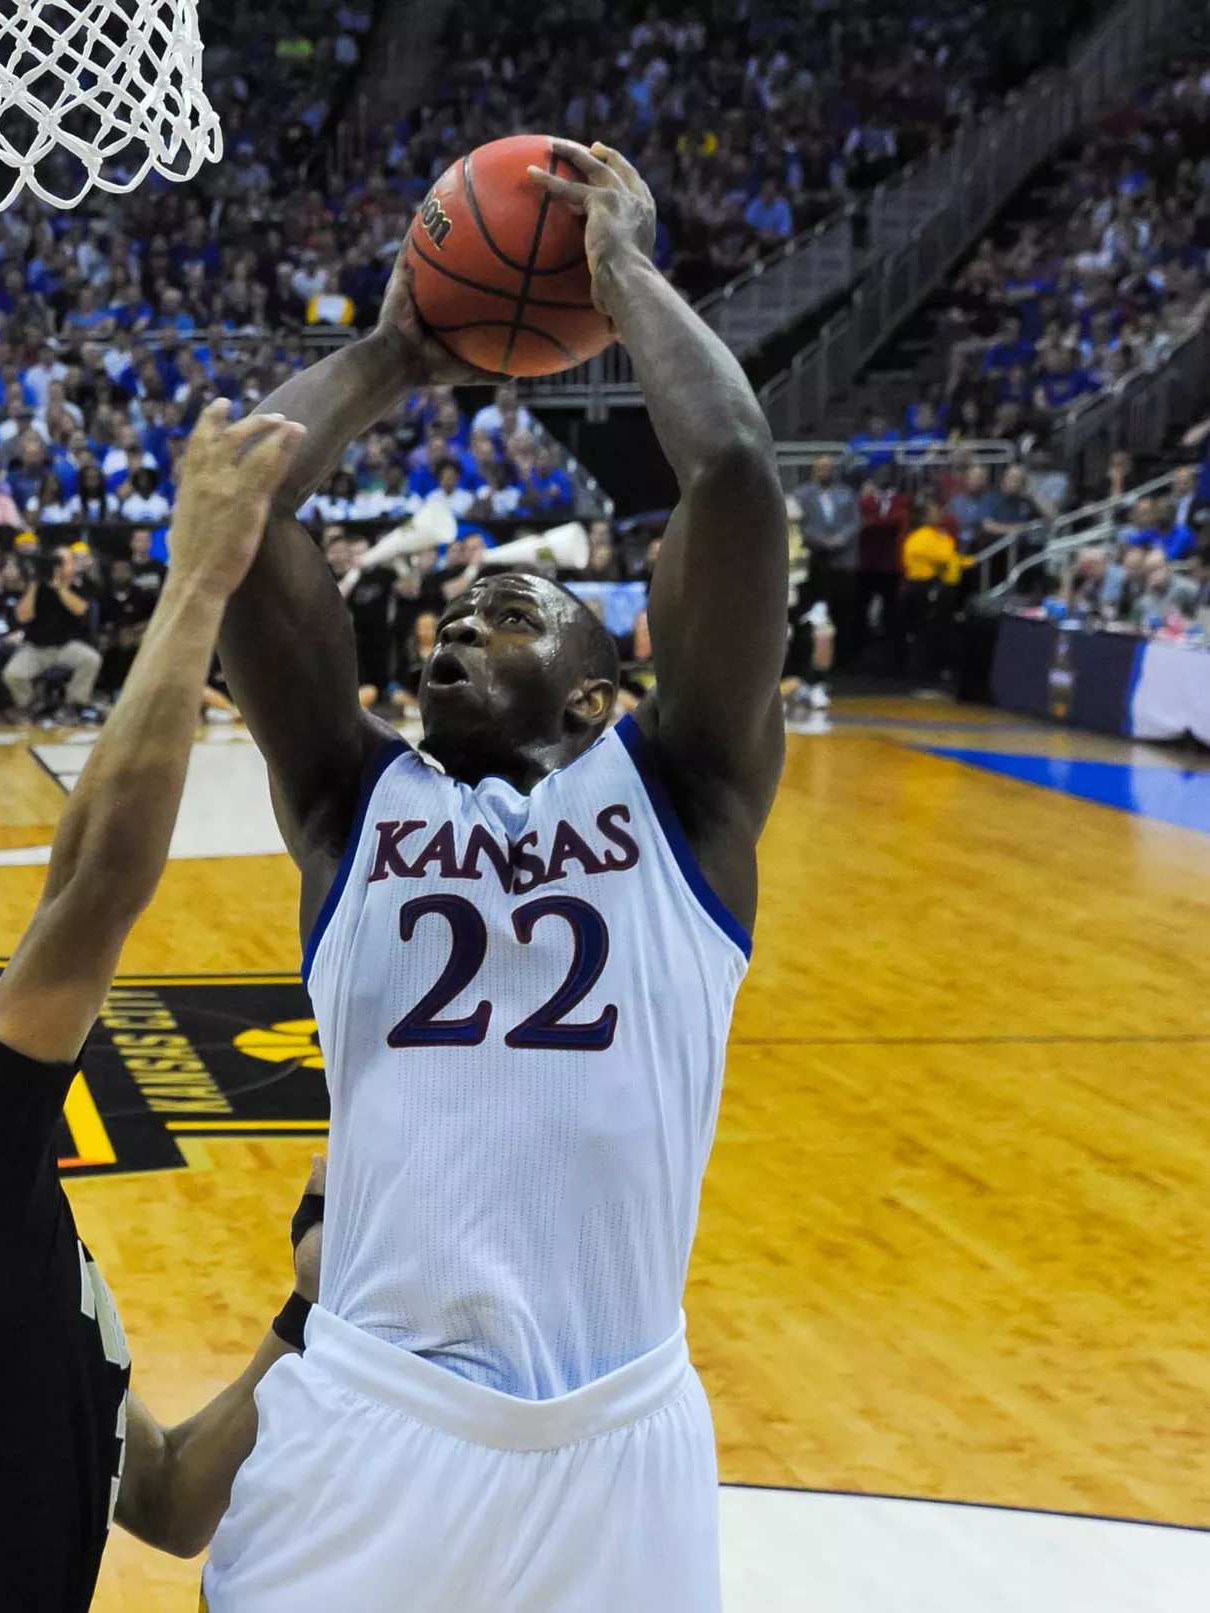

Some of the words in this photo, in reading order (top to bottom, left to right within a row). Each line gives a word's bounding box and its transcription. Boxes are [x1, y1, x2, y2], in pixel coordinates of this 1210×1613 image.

[368, 804, 640, 895] KANSAS
[99, 990, 178, 1029] CITY
[387, 893, 618, 1051] 22
[112, 1034, 233, 1113] KANSAS
